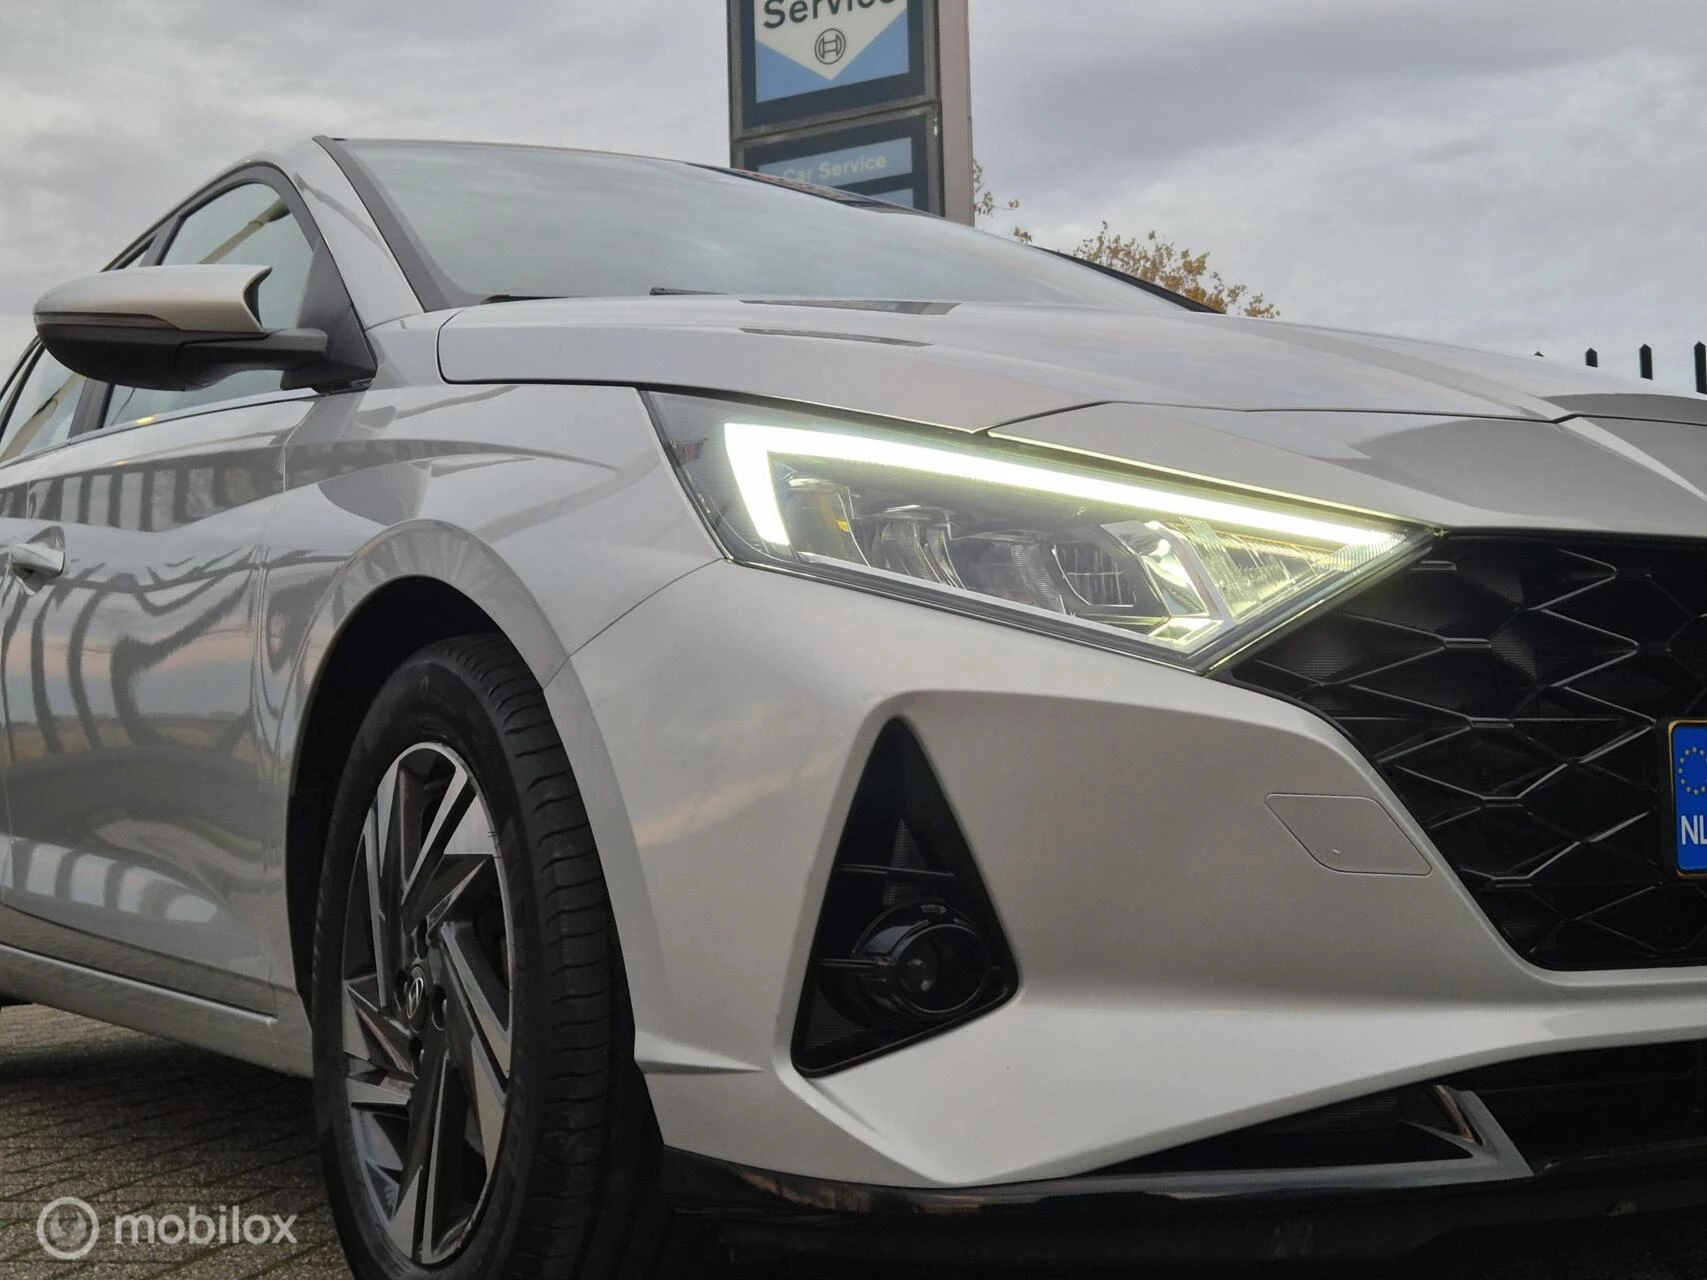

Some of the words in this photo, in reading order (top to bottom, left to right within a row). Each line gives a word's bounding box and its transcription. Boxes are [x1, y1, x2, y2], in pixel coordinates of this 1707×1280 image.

[763, 0, 896, 29] Servi
[782, 167, 812, 183] Car
[819, 154, 887, 179] Service
[1681, 814, 1707, 846] NL
